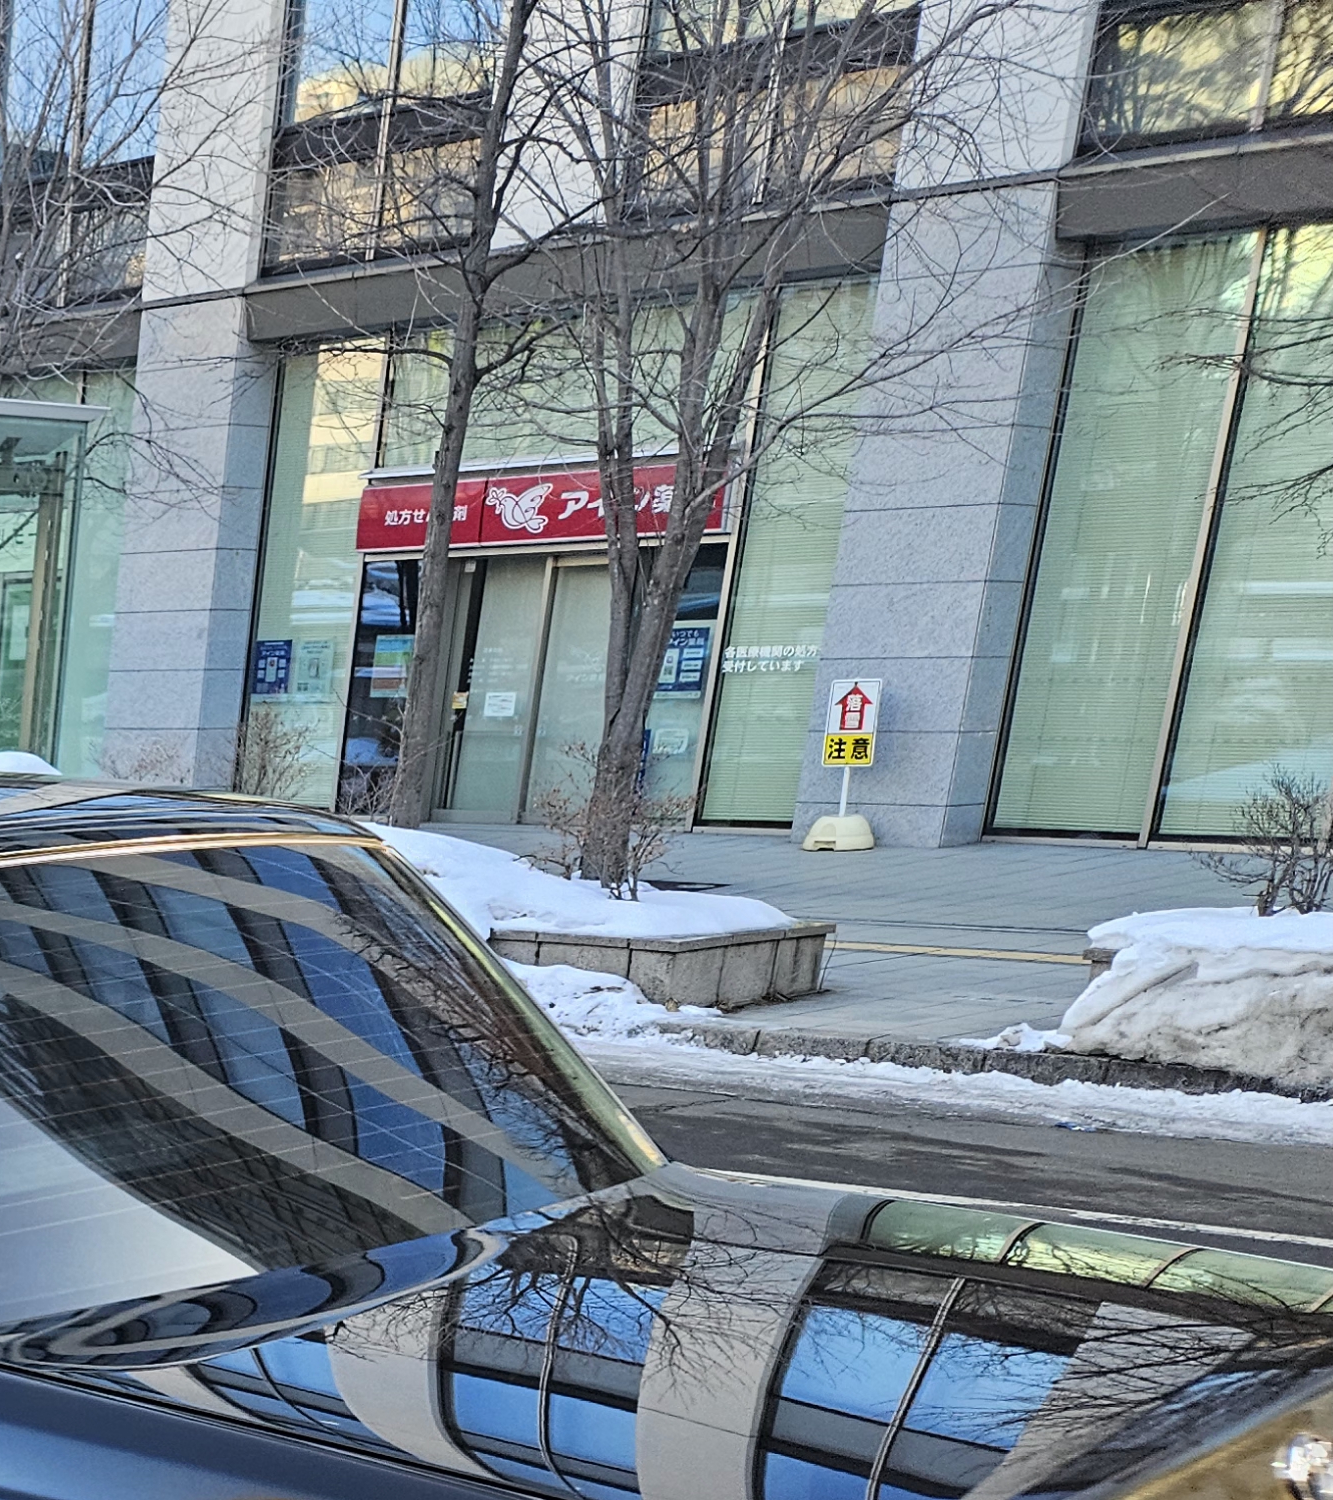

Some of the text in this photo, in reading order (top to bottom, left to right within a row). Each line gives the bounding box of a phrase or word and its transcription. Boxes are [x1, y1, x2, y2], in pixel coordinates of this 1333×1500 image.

[385, 505, 467, 526] 処方せ剤
[723, 660, 805, 673] 受付しています
[828, 738, 870, 760] 注意
